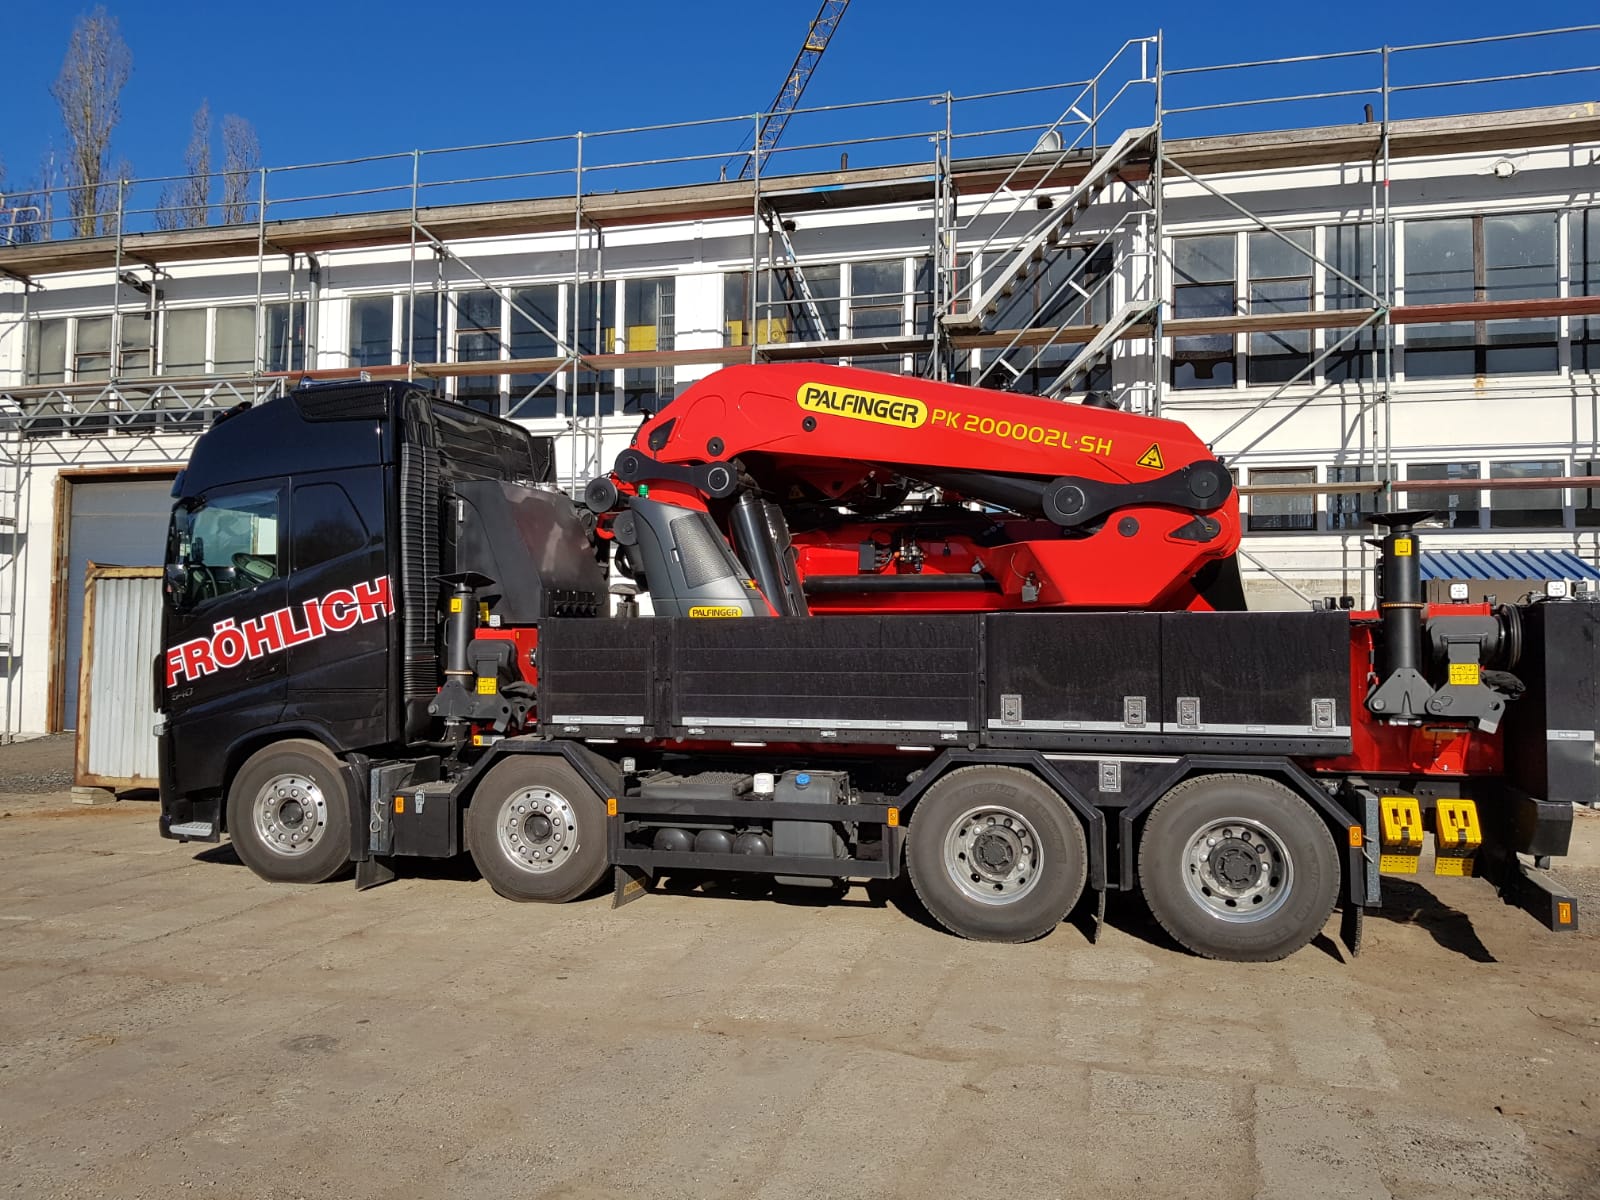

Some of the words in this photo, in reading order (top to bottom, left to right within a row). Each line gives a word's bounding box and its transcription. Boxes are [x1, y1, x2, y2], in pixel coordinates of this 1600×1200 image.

[804, 387, 919, 424] PALFINGER
[931, 408, 961, 429] PK
[692, 608, 739, 617] PALFINGER
[166, 574, 396, 689] FRÖHLICH
